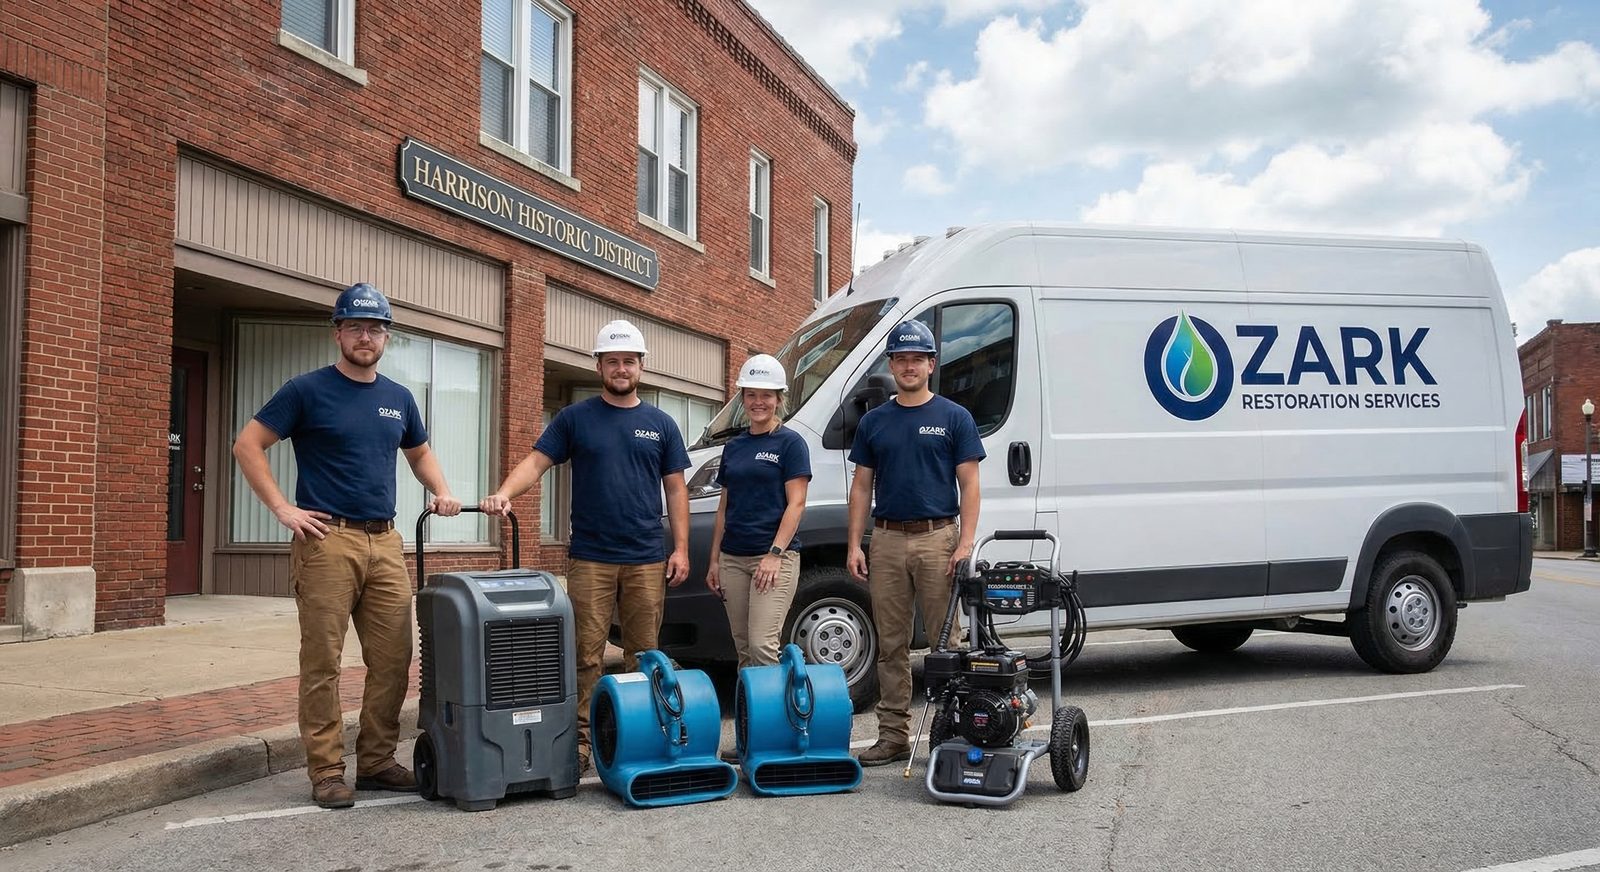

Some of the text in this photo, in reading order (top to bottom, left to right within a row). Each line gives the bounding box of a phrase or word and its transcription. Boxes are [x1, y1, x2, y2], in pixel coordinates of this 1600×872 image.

[413, 155, 652, 279] HARRISON HISTORIC DISTRICT
[1144, 309, 1438, 421] OZARK
[1242, 392, 1441, 410] RESTORATION SERVICES
[634, 429, 659, 438] OZARK
[919, 426, 946, 434] OZARK
